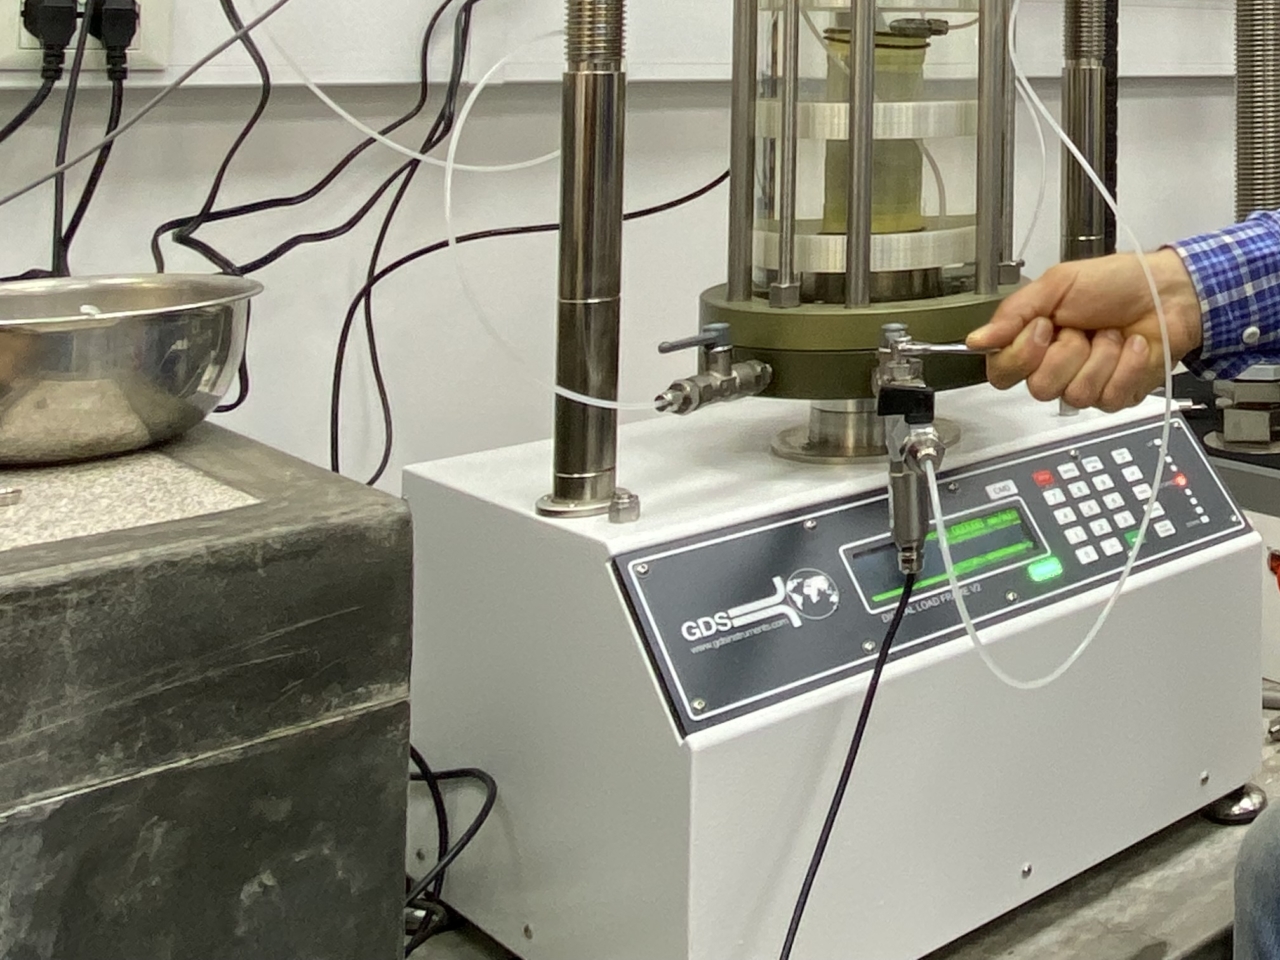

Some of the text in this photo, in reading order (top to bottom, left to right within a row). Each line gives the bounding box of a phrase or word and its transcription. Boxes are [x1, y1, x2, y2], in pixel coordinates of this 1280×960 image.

[916, 596, 940, 612] LOAD
[681, 612, 732, 641] GDS
[690, 618, 789, 654] www.gdsinstruments.com
